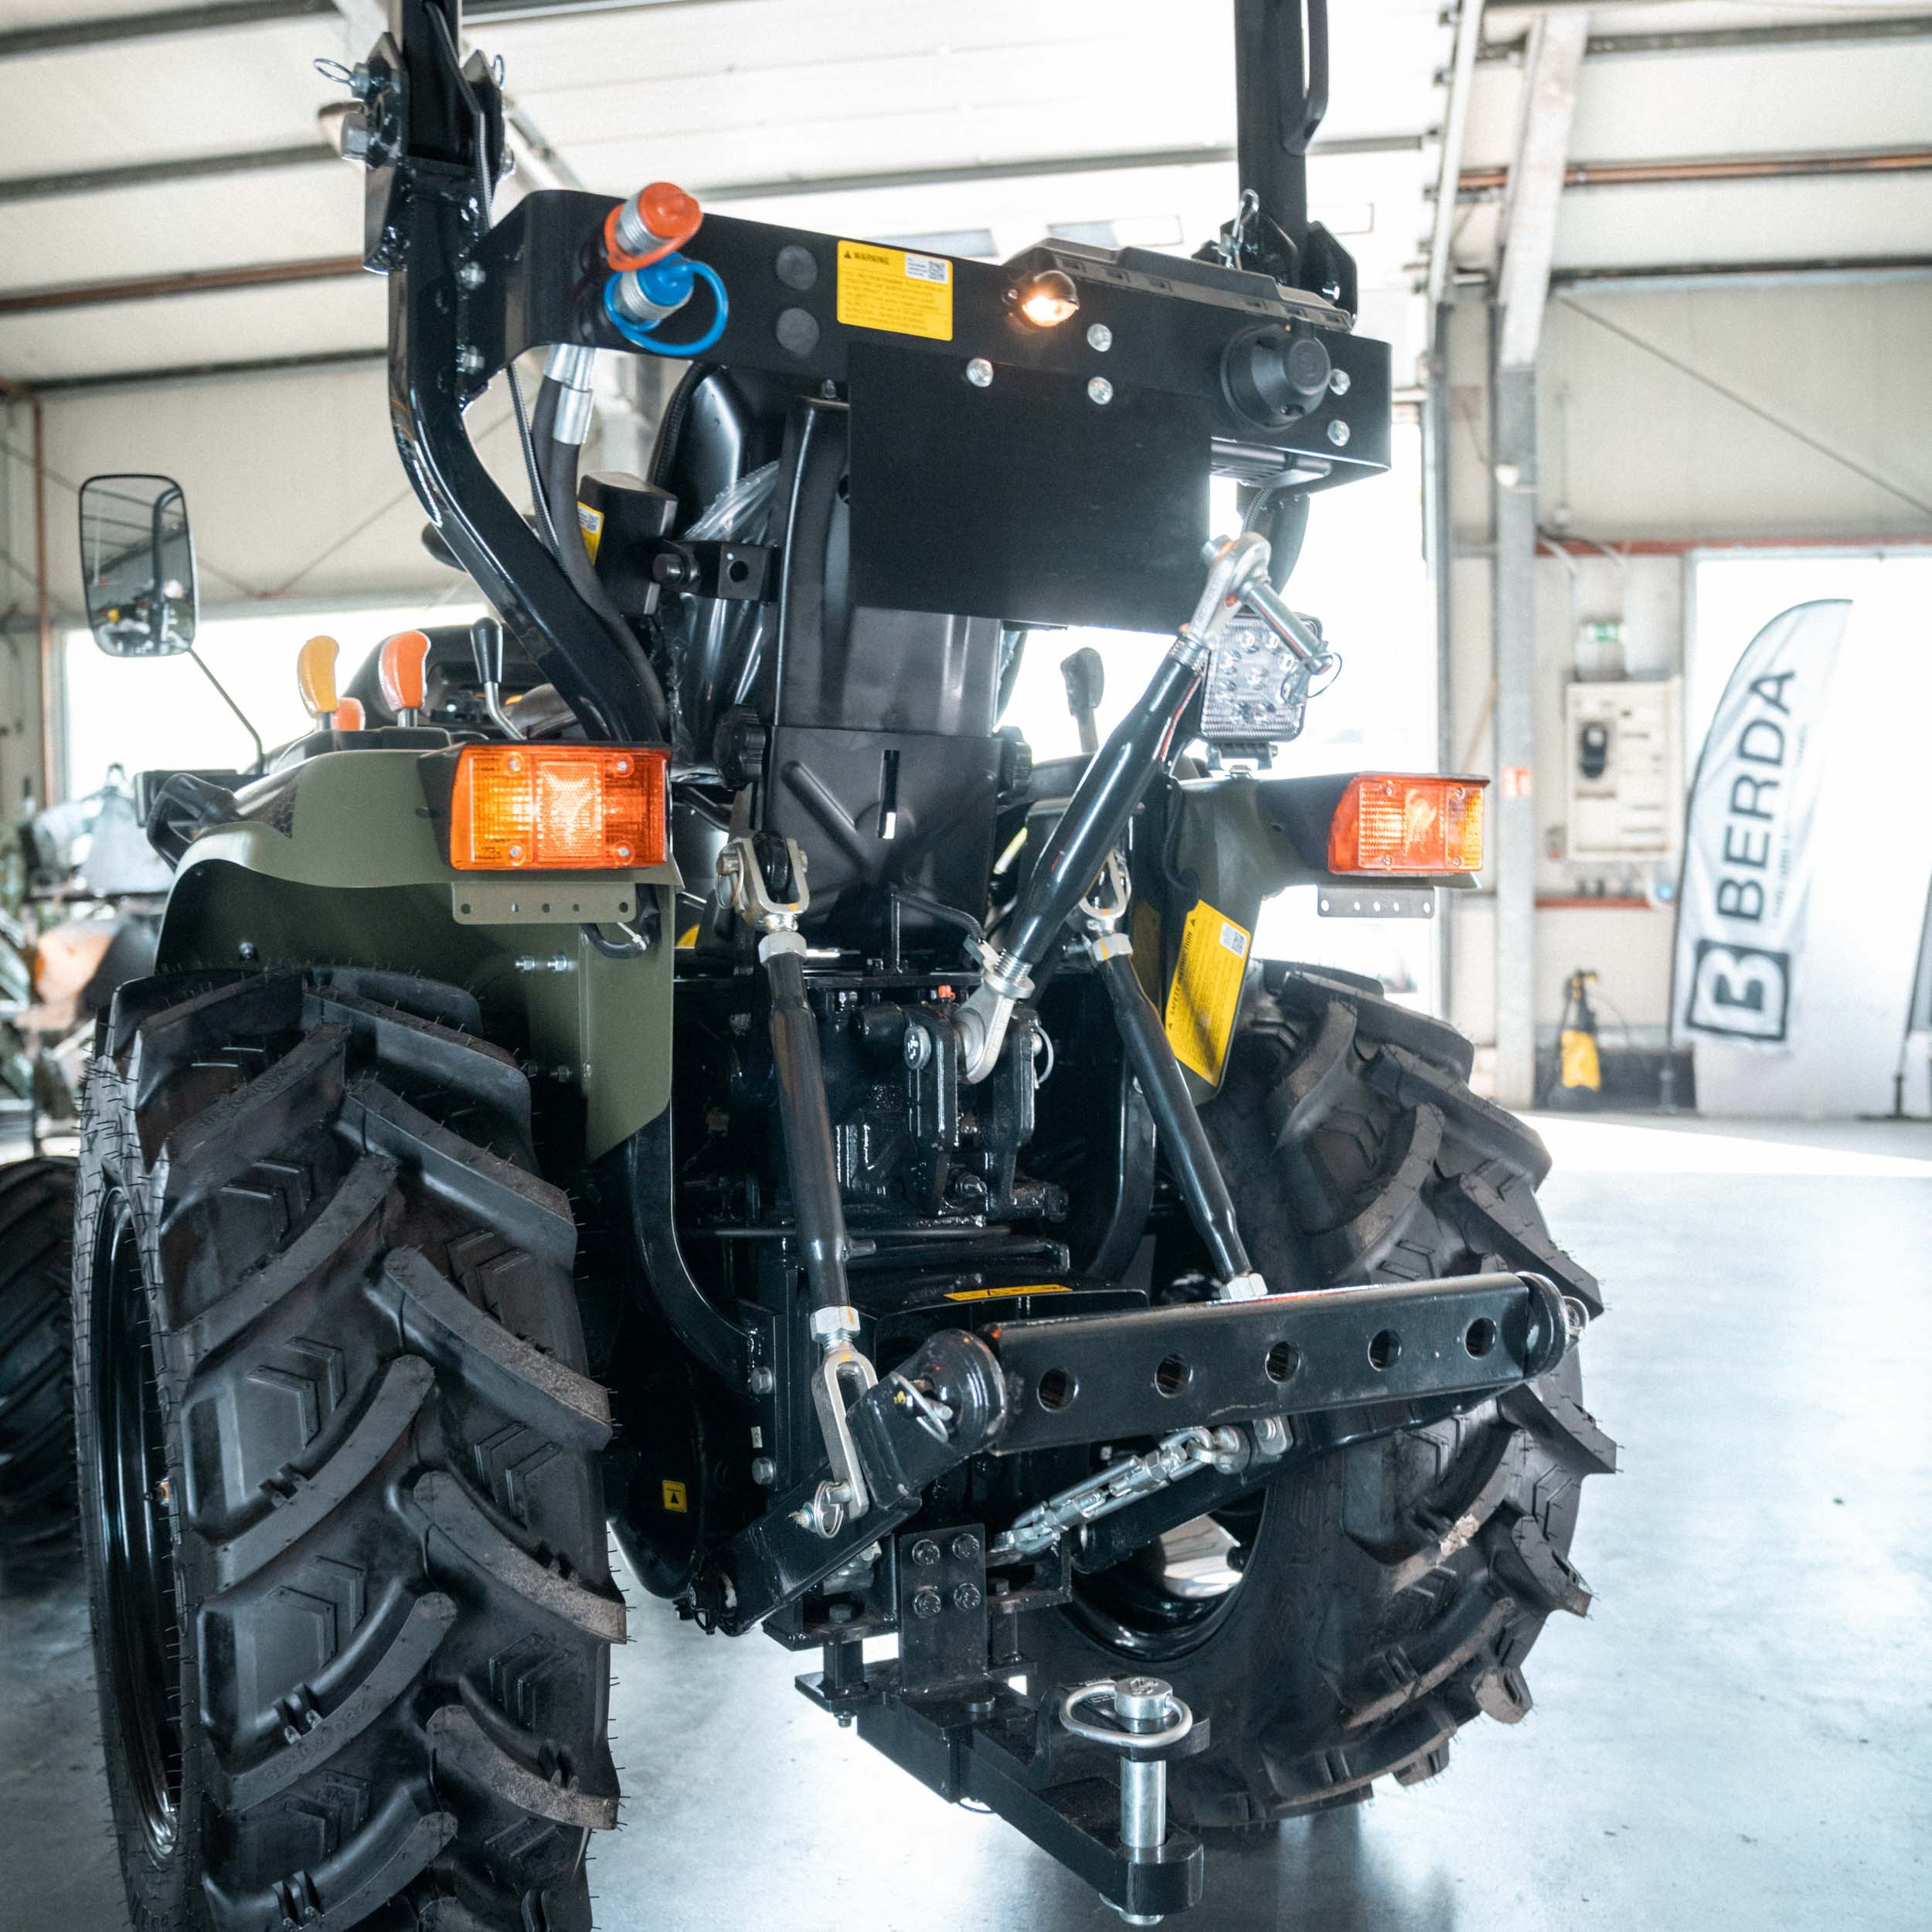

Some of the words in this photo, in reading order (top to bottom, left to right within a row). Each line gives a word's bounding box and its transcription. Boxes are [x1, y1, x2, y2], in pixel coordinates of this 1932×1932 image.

[853, 252, 890, 265] WARNING
[1715, 668, 1797, 923] BERDA
[1170, 986, 1180, 1015] SAFETY
[1177, 930, 1192, 985] INSTRUCTION
